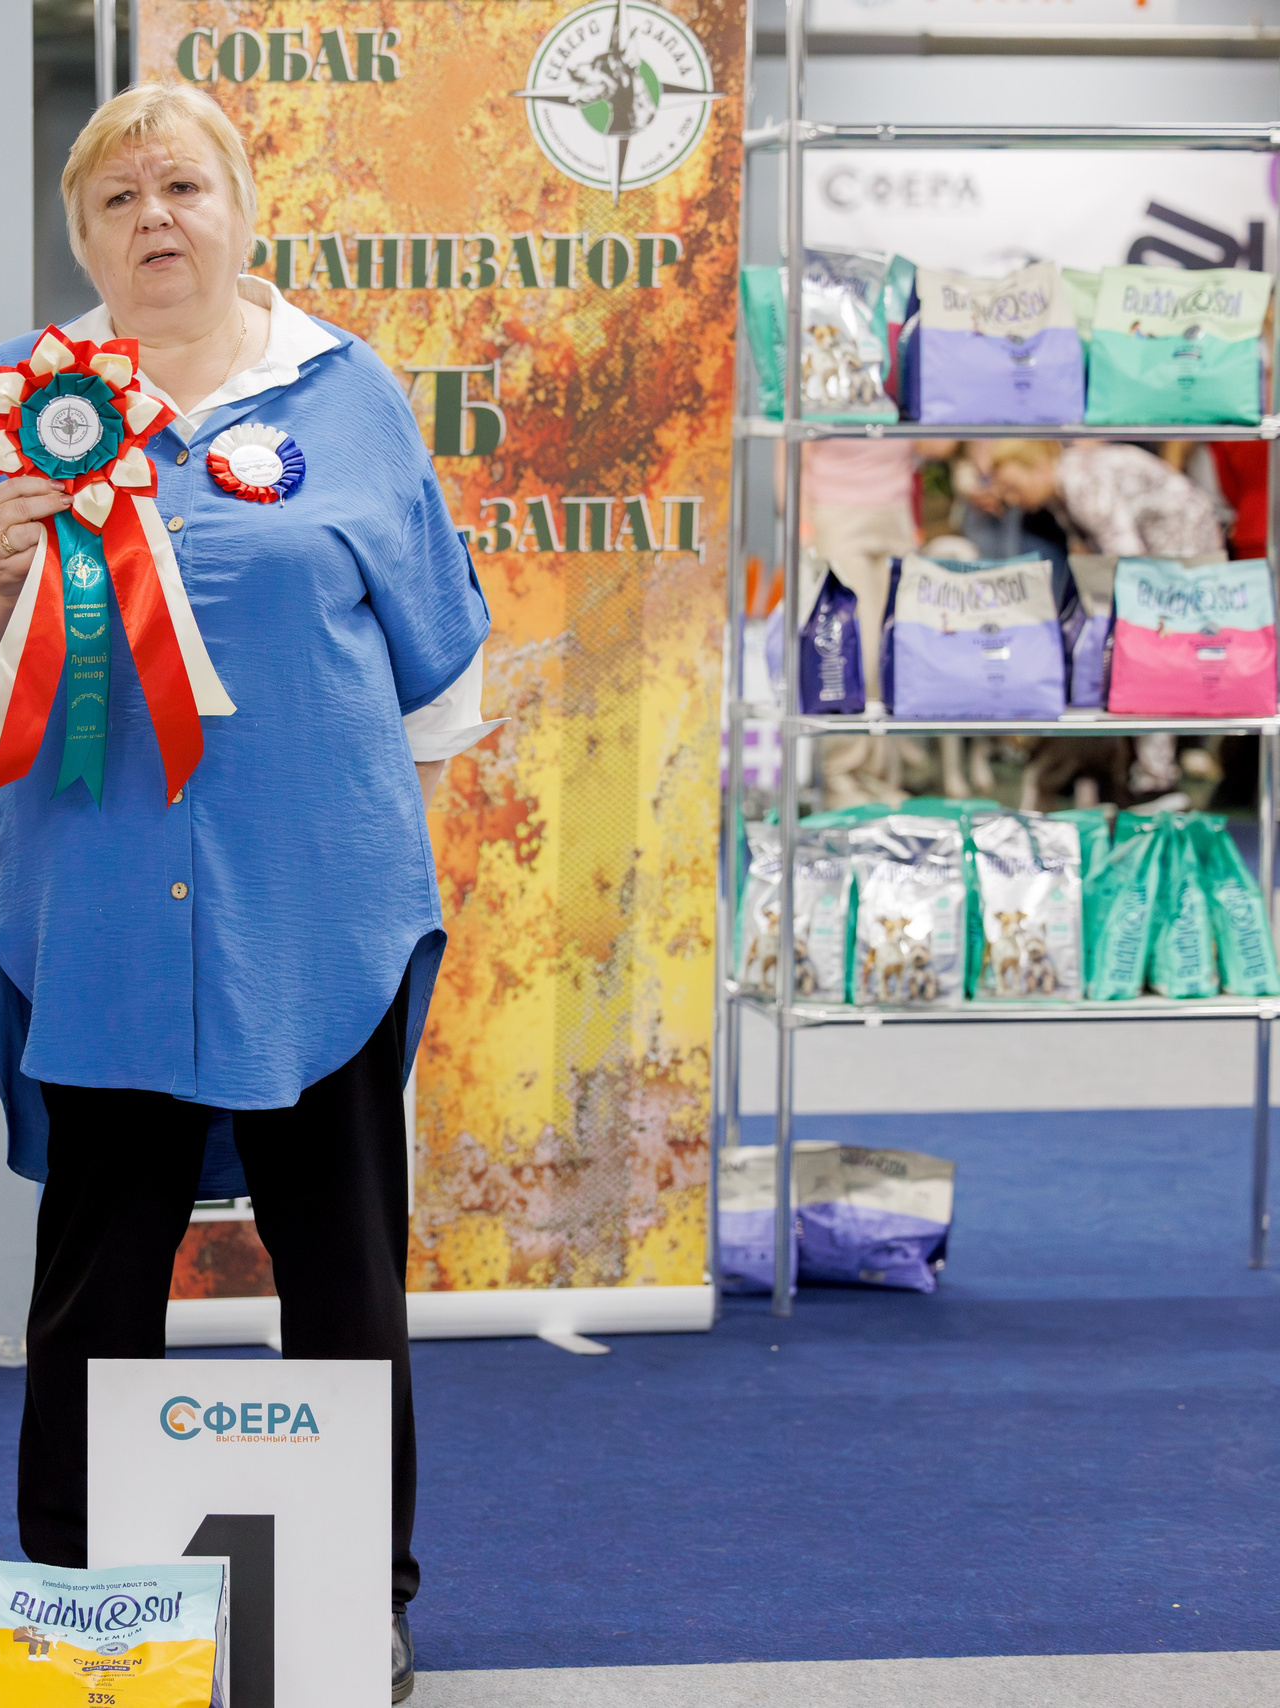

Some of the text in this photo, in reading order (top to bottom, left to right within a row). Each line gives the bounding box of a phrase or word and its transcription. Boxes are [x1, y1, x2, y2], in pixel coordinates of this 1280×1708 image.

[177, 24, 403, 83] СОБАК
[245, 231, 684, 290] РГАНИЗАТОР
[71, 652, 107, 666] Лучший
[74, 671, 105, 680] юниор
[160, 1395, 320, 1441] СФЕРА
[216, 1434, 320, 1443] ВЫСТАВОЧНЫЙ ЦЕНТР
[42, 1580, 71, 1591] Friendship
[73, 1584, 89, 1592] story
[181, 1514, 275, 1708] 1
[88, 1627, 142, 1641] PREMIUM
[73, 1658, 143, 1666] CHICKEN
[87, 1692, 116, 1705] 33%
